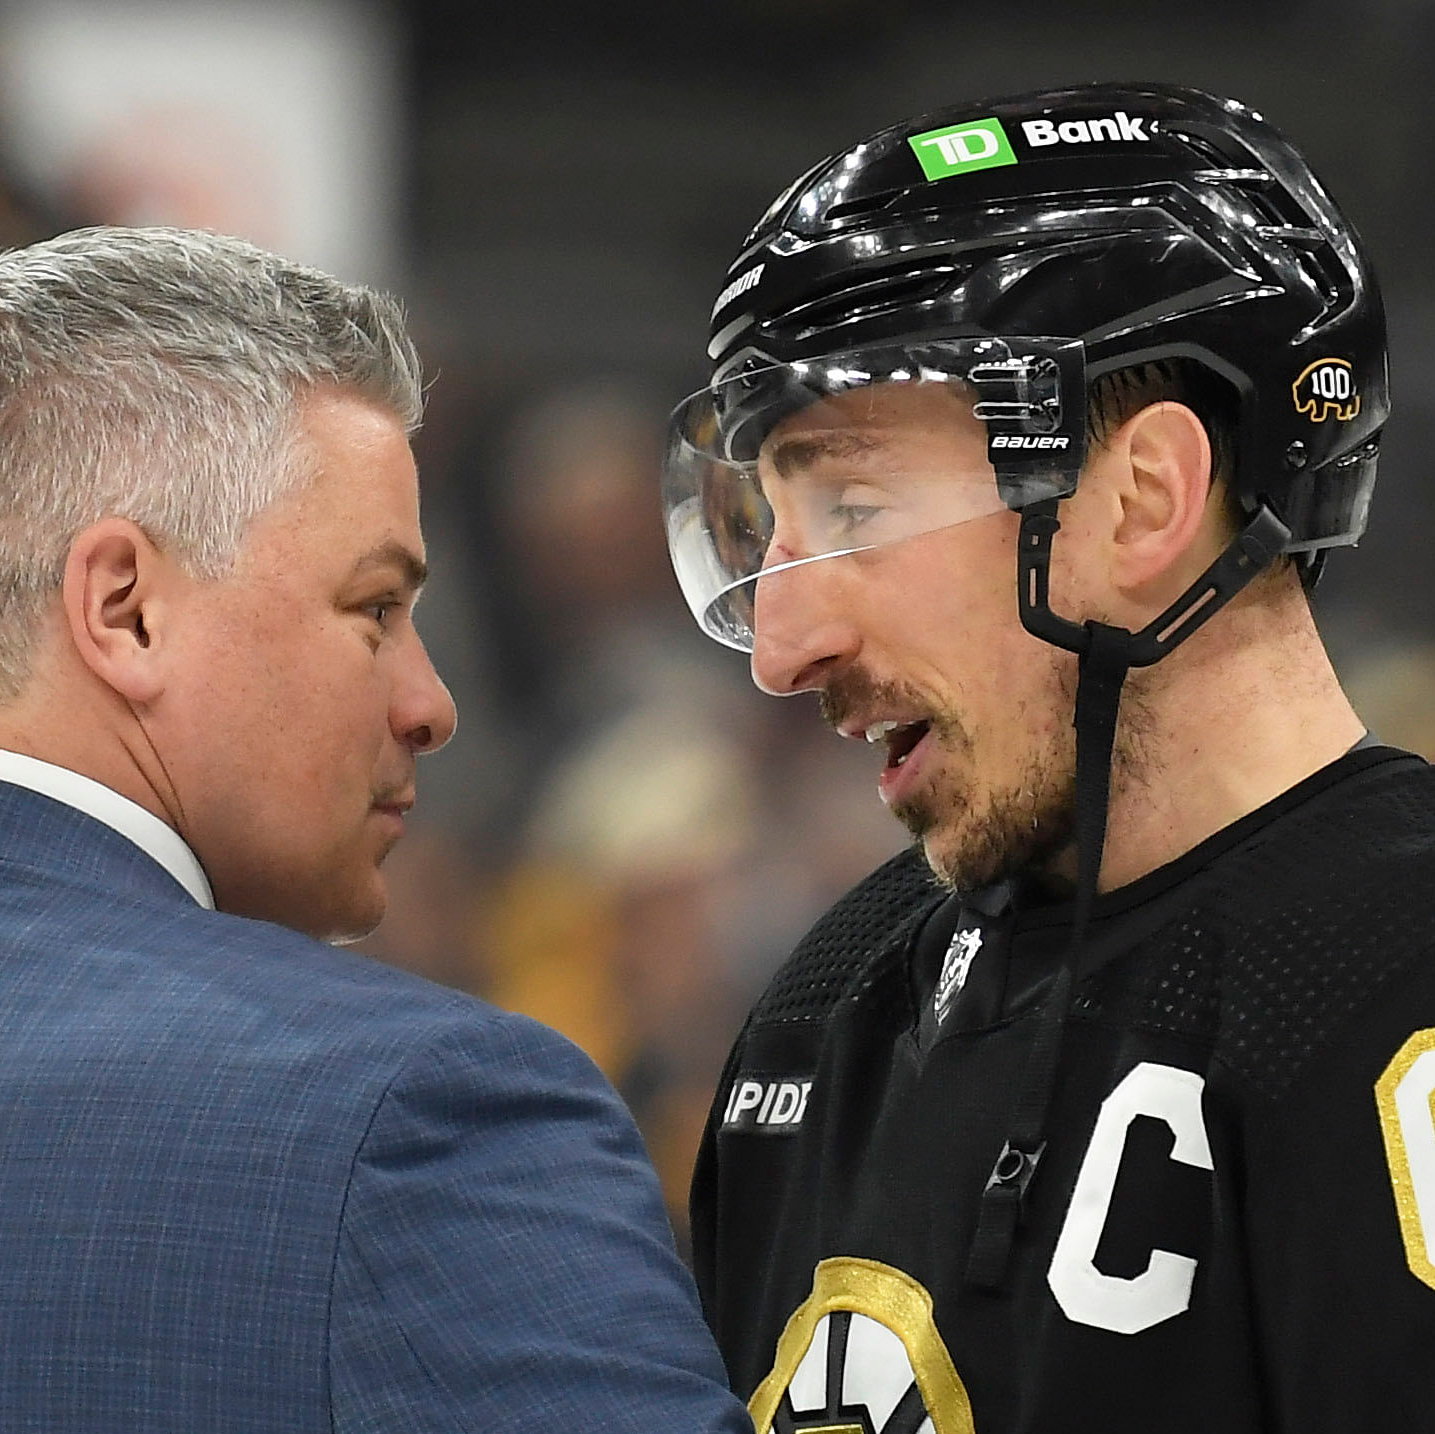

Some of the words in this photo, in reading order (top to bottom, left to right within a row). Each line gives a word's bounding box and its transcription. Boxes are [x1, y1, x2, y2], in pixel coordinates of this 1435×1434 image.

[920, 127, 1000, 166] TD
[1021, 111, 1150, 148] Bank
[1311, 366, 1350, 400] 100
[1046, 1061, 1215, 1335] C
